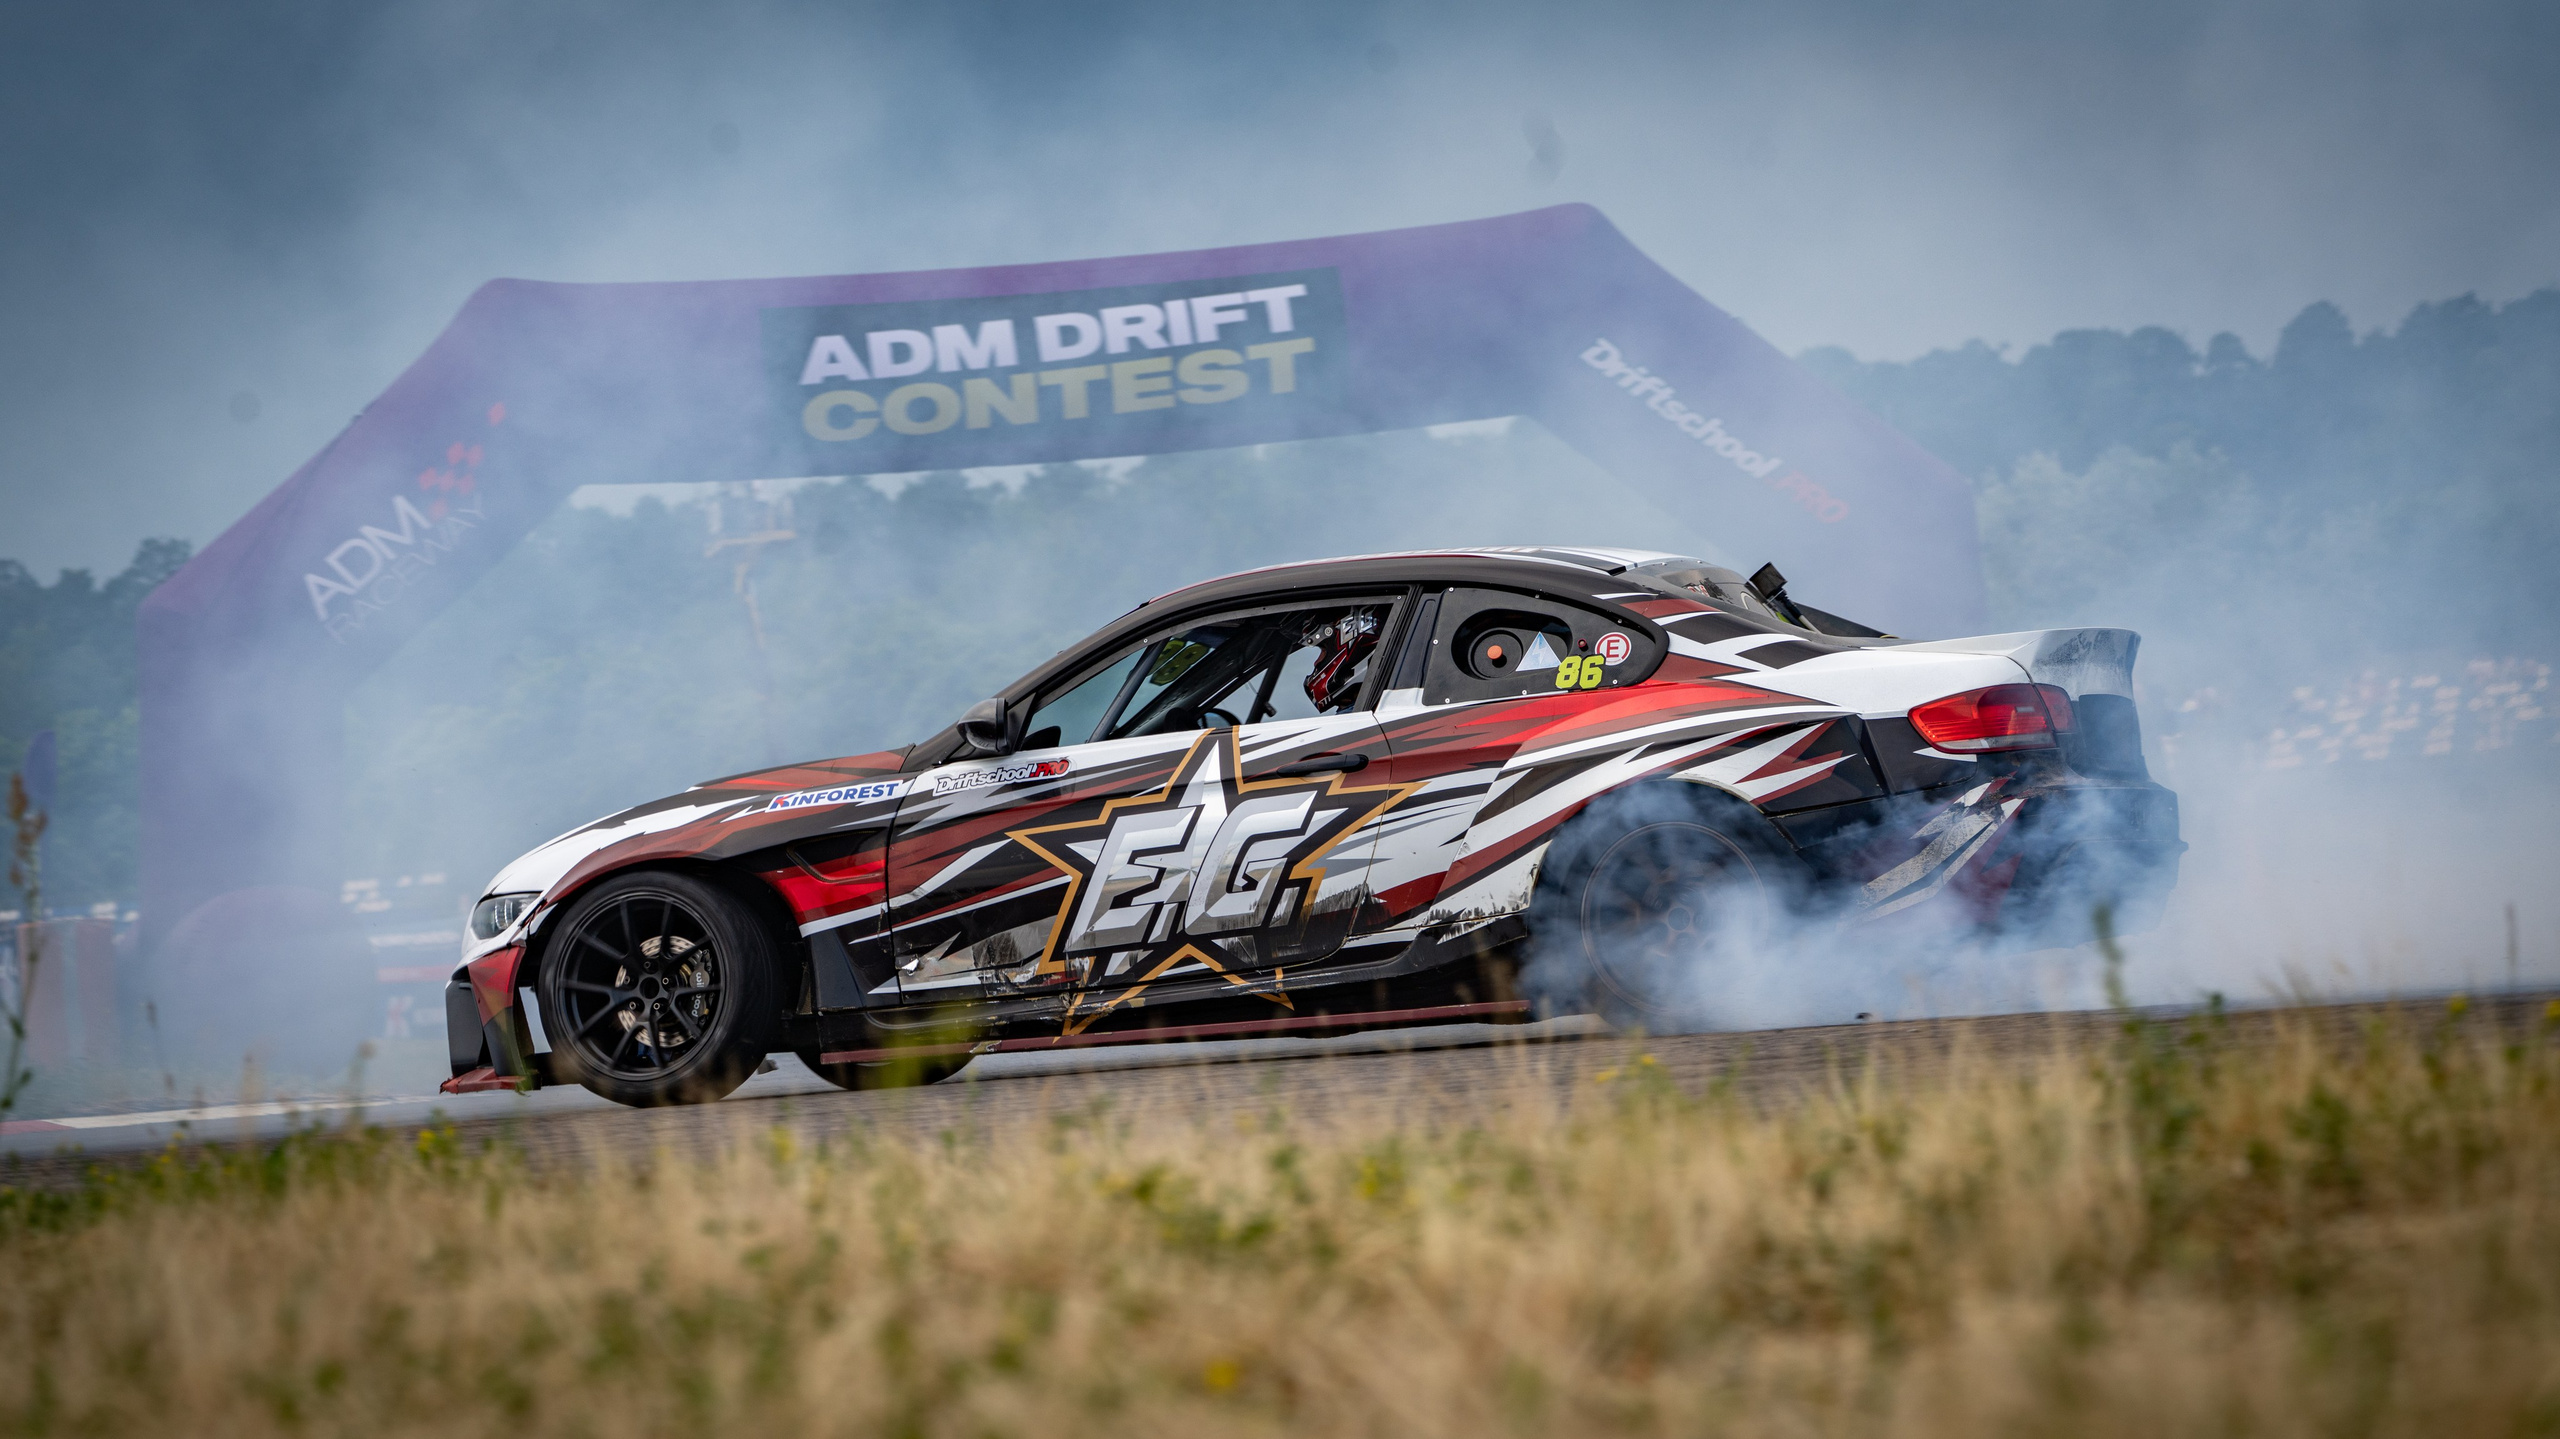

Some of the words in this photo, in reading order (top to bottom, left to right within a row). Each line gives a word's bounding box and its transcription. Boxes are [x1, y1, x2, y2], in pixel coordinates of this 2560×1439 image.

[800, 319, 1018, 385] ADM
[1034, 284, 1308, 363] DRIFT
[802, 337, 1316, 442] CONTEST
[304, 494, 432, 622] ADM
[1606, 639, 1620, 658] E
[1555, 655, 1605, 689] 86
[769, 783, 899, 810] KINFOREST
[691, 972, 705, 1018] wilood
